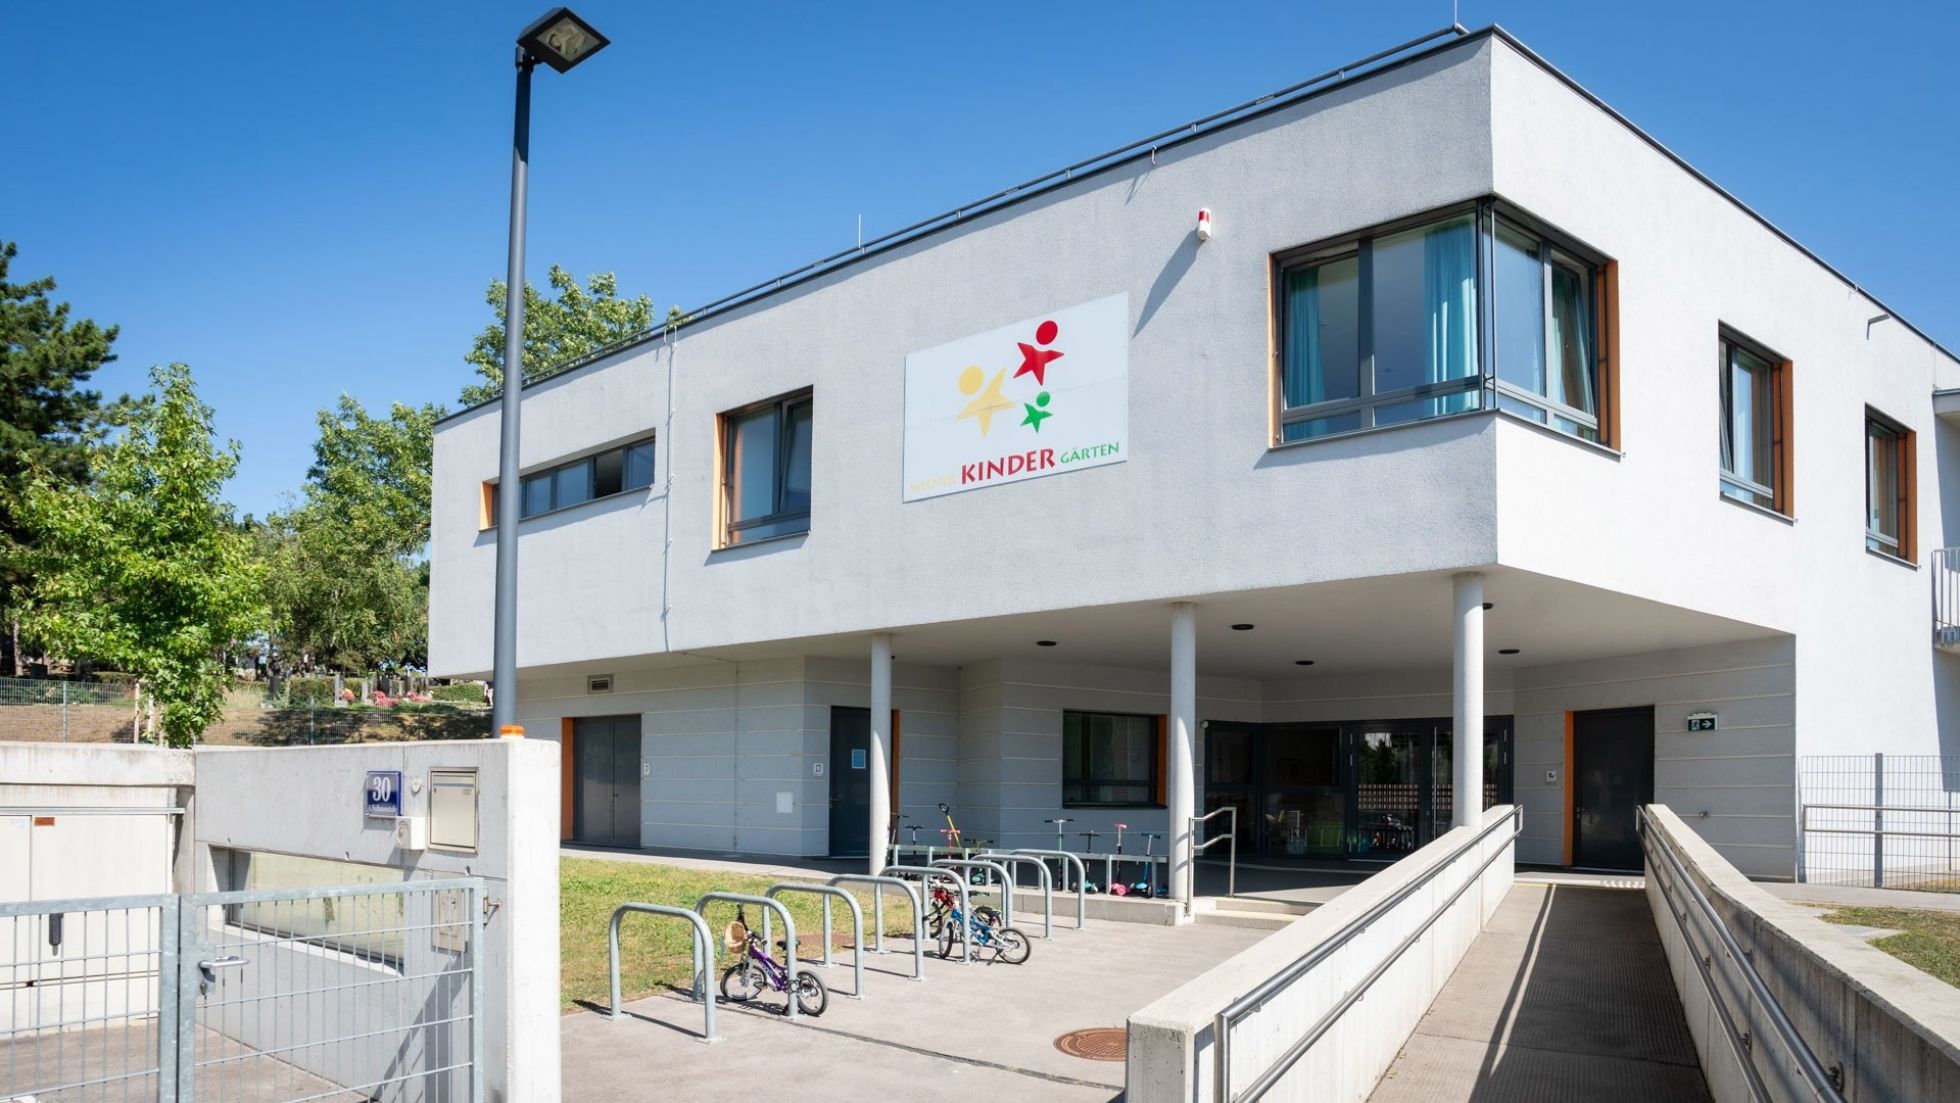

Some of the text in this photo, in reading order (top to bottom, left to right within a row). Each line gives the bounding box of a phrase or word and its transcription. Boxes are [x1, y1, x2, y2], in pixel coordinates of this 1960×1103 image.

[961, 448, 1055, 485] KINDER
[1060, 442, 1119, 464] GÄRTEN
[372, 776, 391, 802] 30
